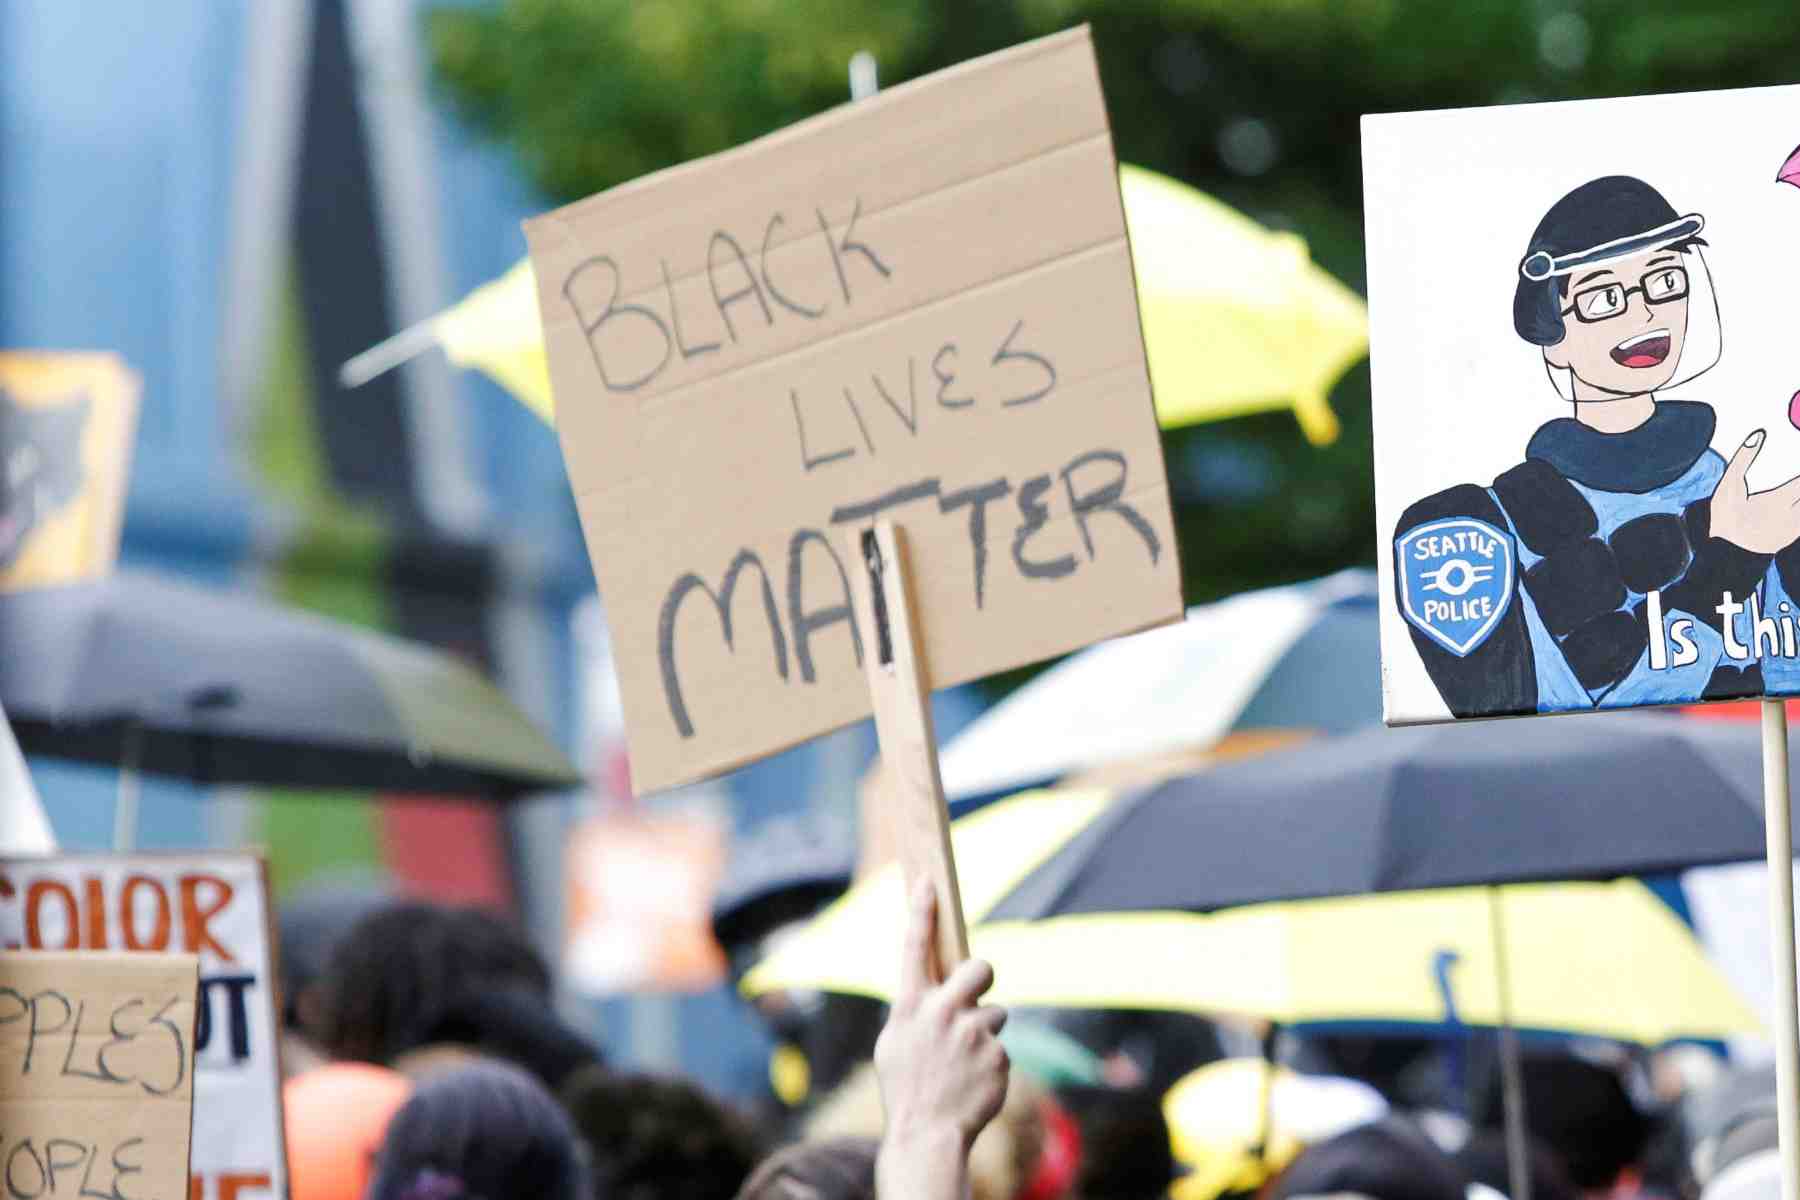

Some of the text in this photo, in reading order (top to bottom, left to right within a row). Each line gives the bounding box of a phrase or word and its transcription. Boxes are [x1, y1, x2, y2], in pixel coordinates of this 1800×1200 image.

[562, 198, 891, 391] BLACK
[789, 319, 1056, 471] LIVES
[657, 449, 1161, 738] MATTER
[1414, 531, 1497, 560] SEATTLE
[1423, 596, 1493, 623] POLICE
[1646, 589, 1700, 671] Is
